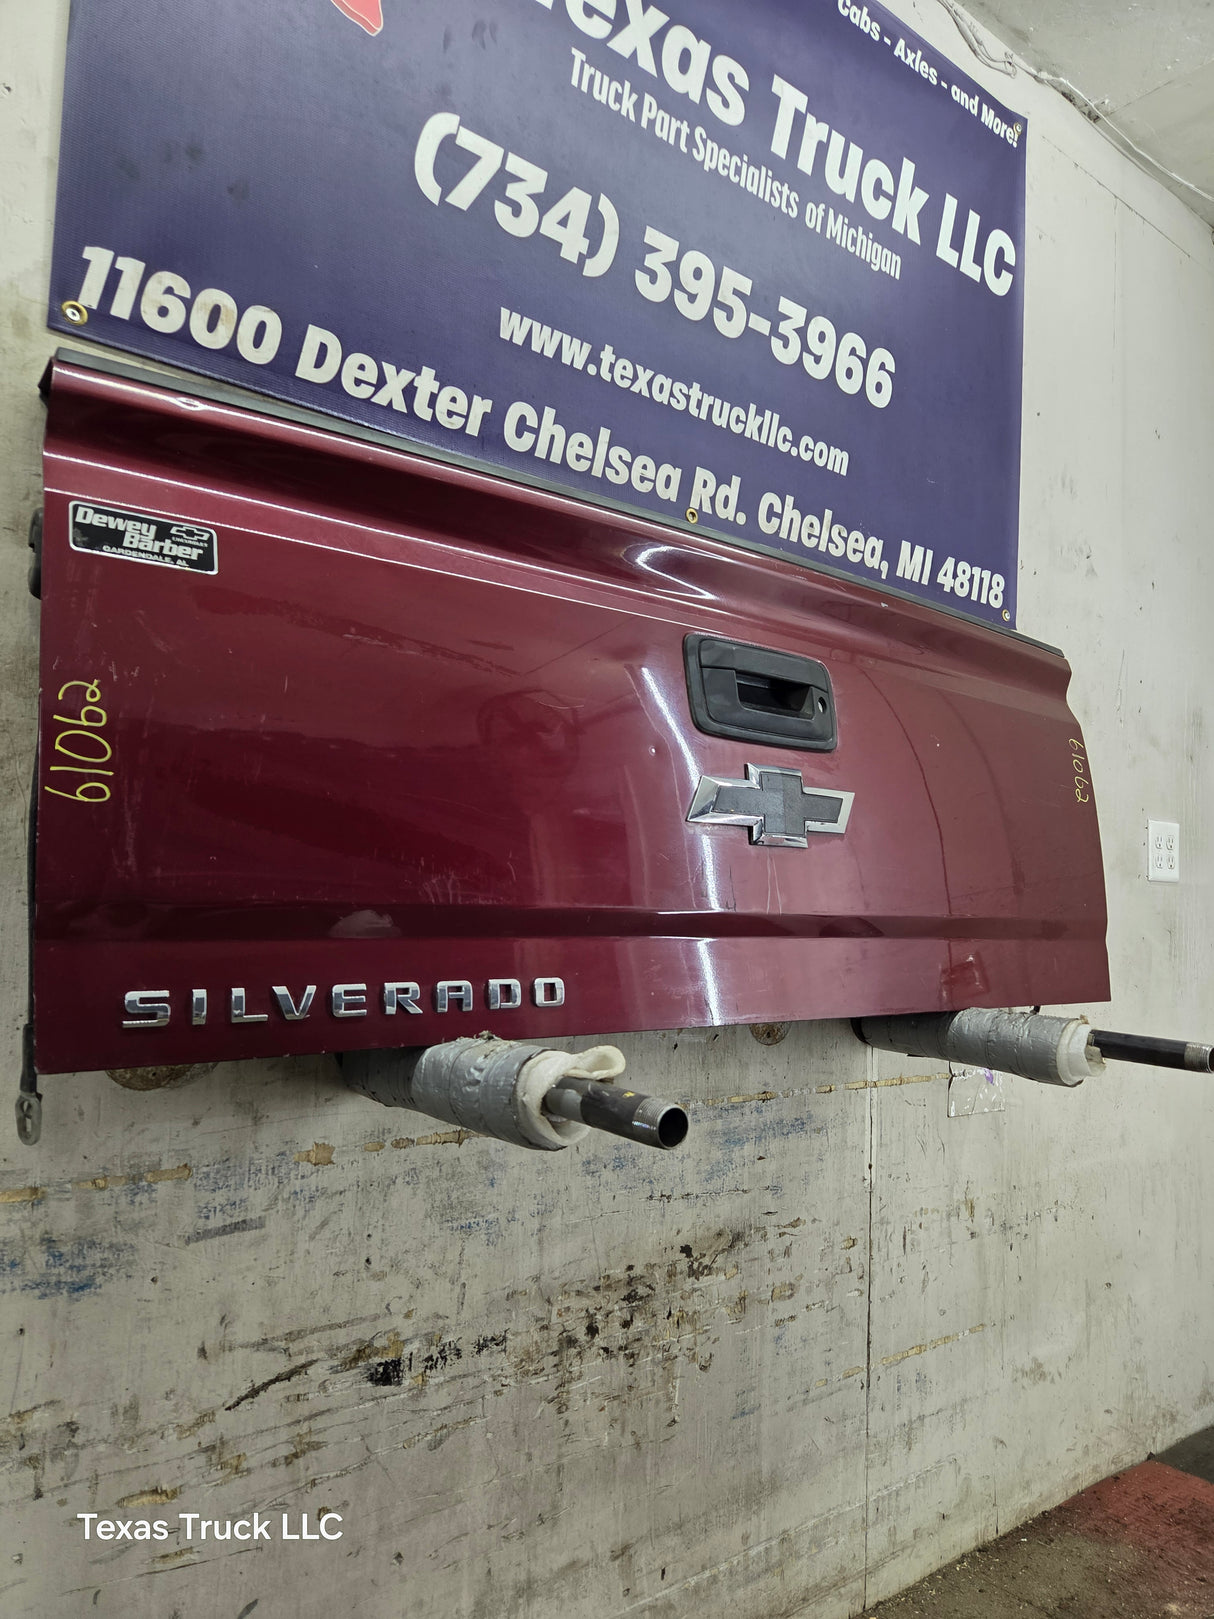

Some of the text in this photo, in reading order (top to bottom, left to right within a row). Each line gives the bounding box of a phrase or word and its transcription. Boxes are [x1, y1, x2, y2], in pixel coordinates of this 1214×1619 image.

[838, 0, 880, 41] Cabs
[893, 38, 938, 86] Axles
[951, 85, 979, 117] and
[536, 0, 1016, 296] exas Truck LLC
[571, 47, 901, 281] Truck Part Specialists of Michigan
[414, 112, 895, 408] (734) 395-3966
[77, 246, 1006, 609] 11600 Dexter Chelsea Rd. Chelsea, MI 48118
[500, 307, 849, 476] www.texastruckllc.com
[75, 506, 157, 539] Dewey
[123, 531, 203, 560] Barber
[44, 679, 114, 802] 61062
[1069, 738, 1089, 803] 61062
[122, 977, 565, 1029] SILVERADO
